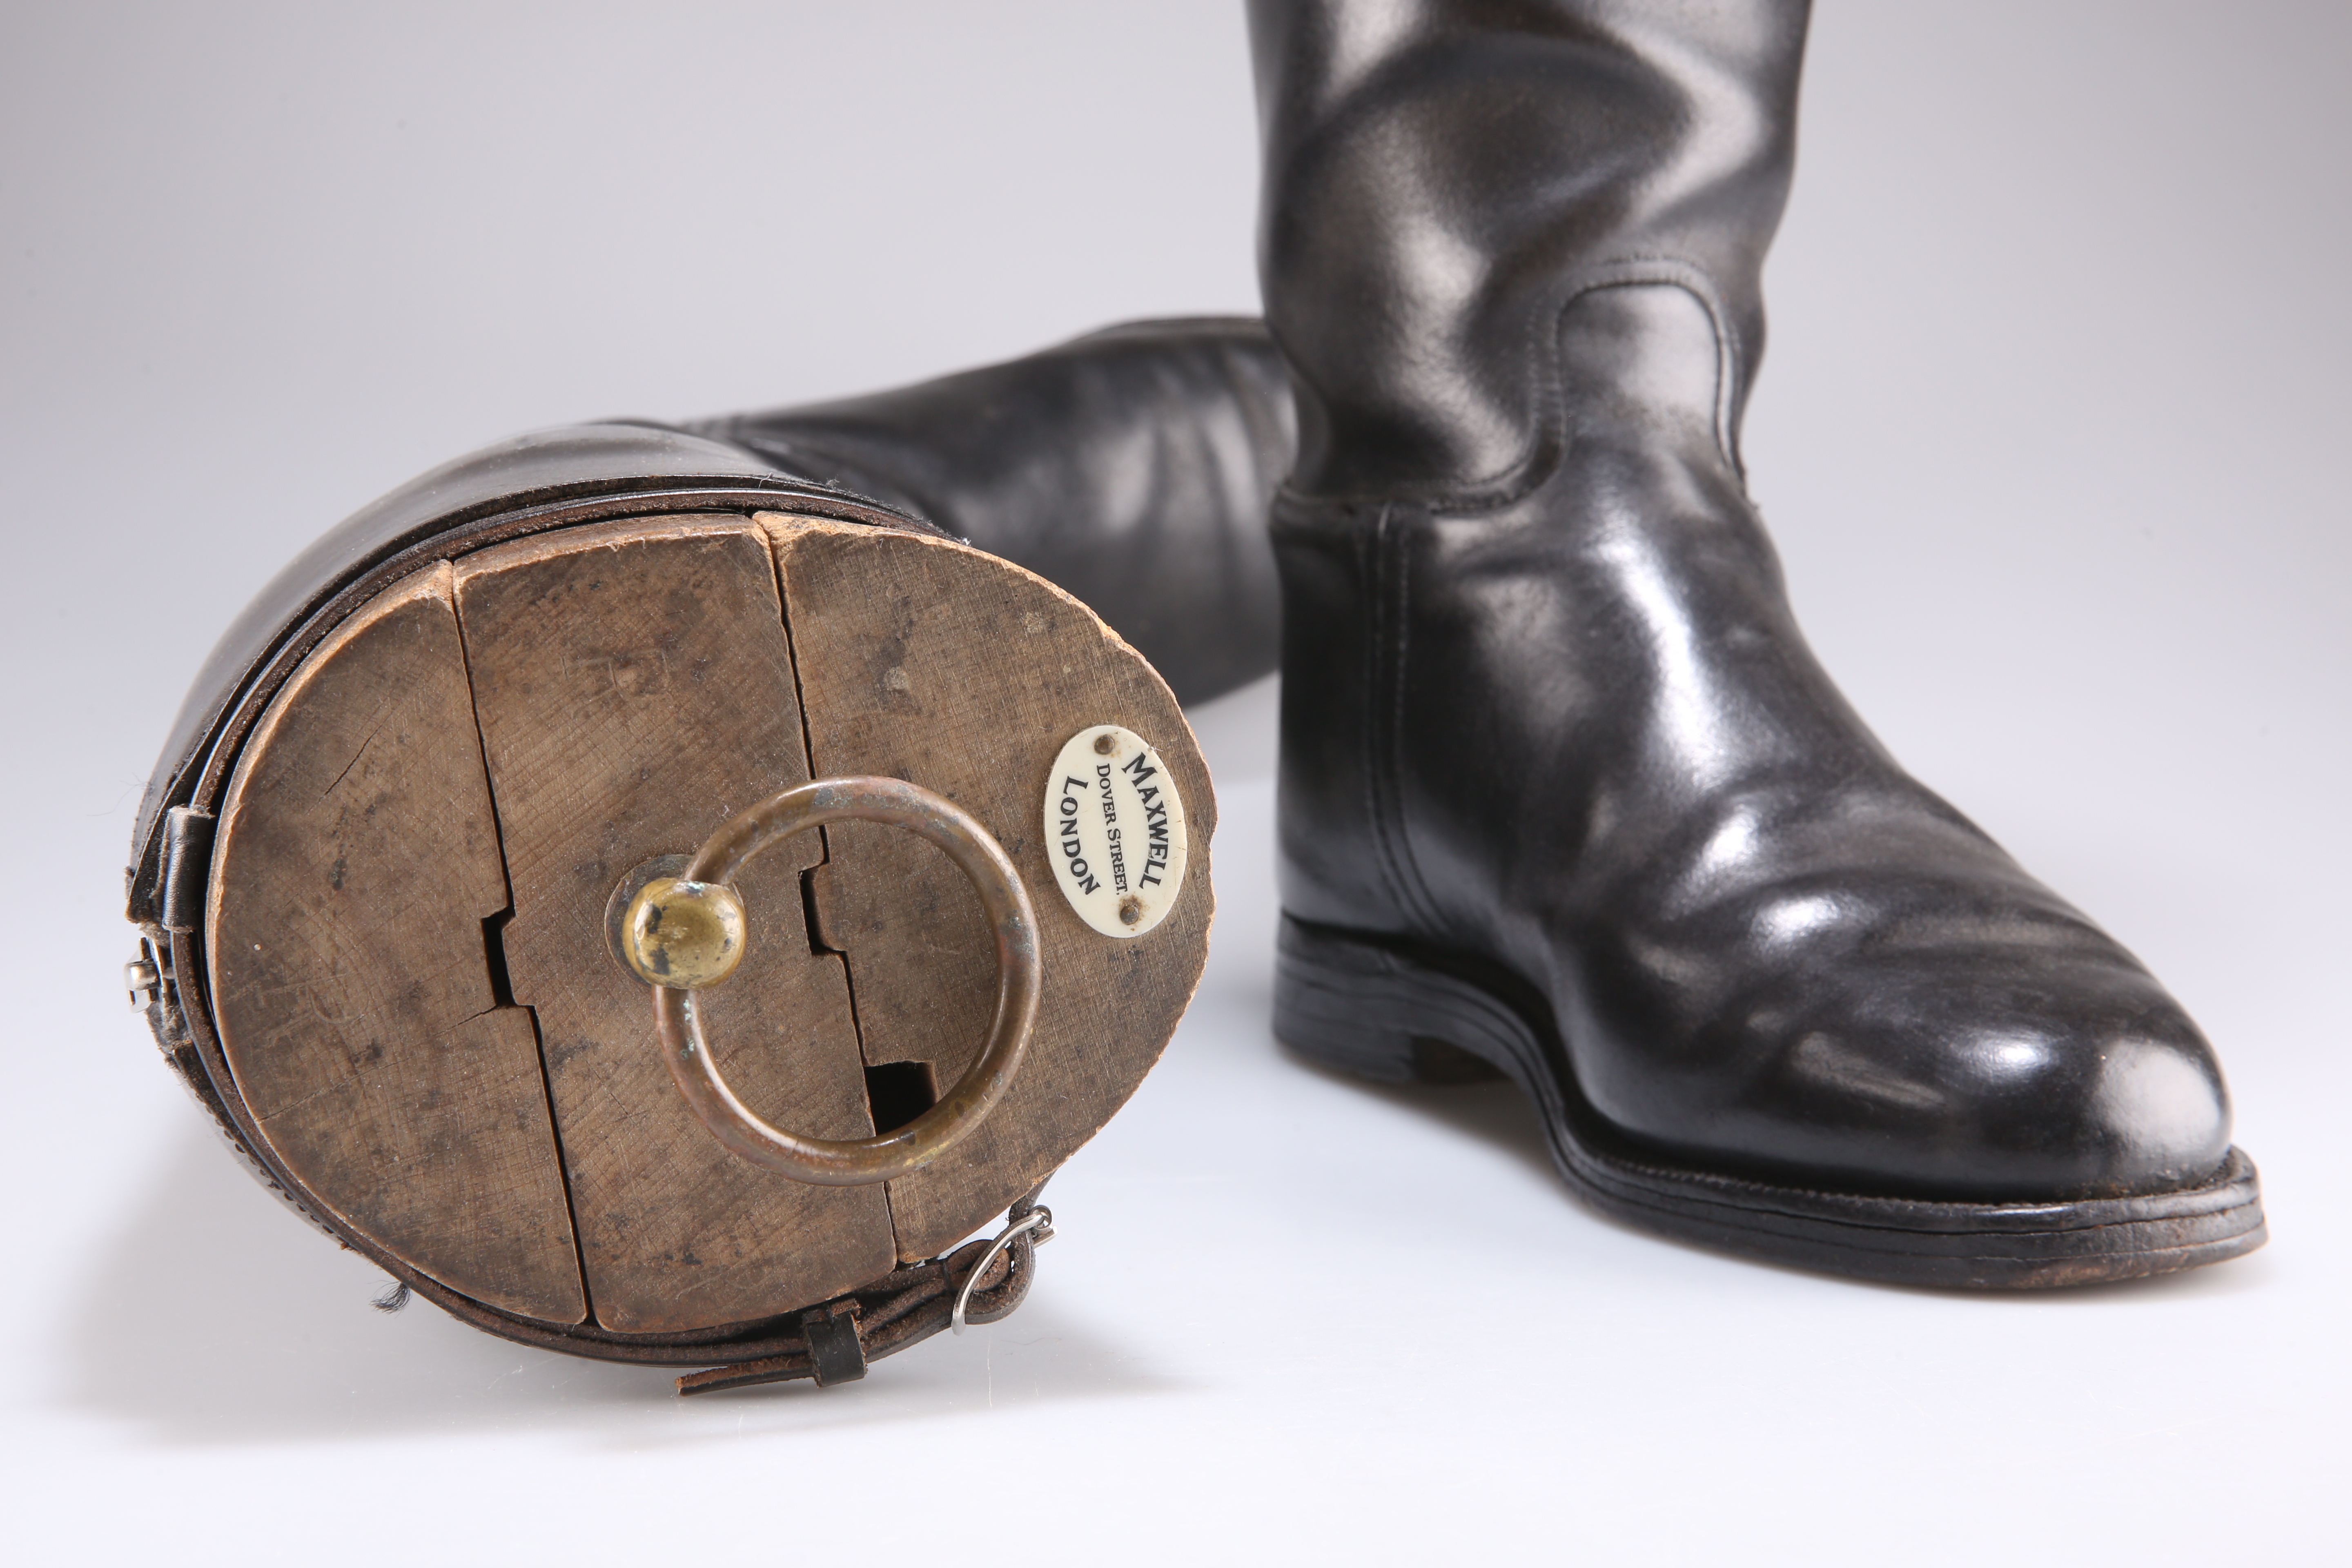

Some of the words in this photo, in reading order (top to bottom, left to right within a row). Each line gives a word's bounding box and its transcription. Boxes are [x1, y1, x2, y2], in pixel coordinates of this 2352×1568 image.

[1060, 776, 1101, 895] LONDON
[1096, 763, 1117, 826] DOVER
[1121, 752, 1169, 889] MAXWELL
